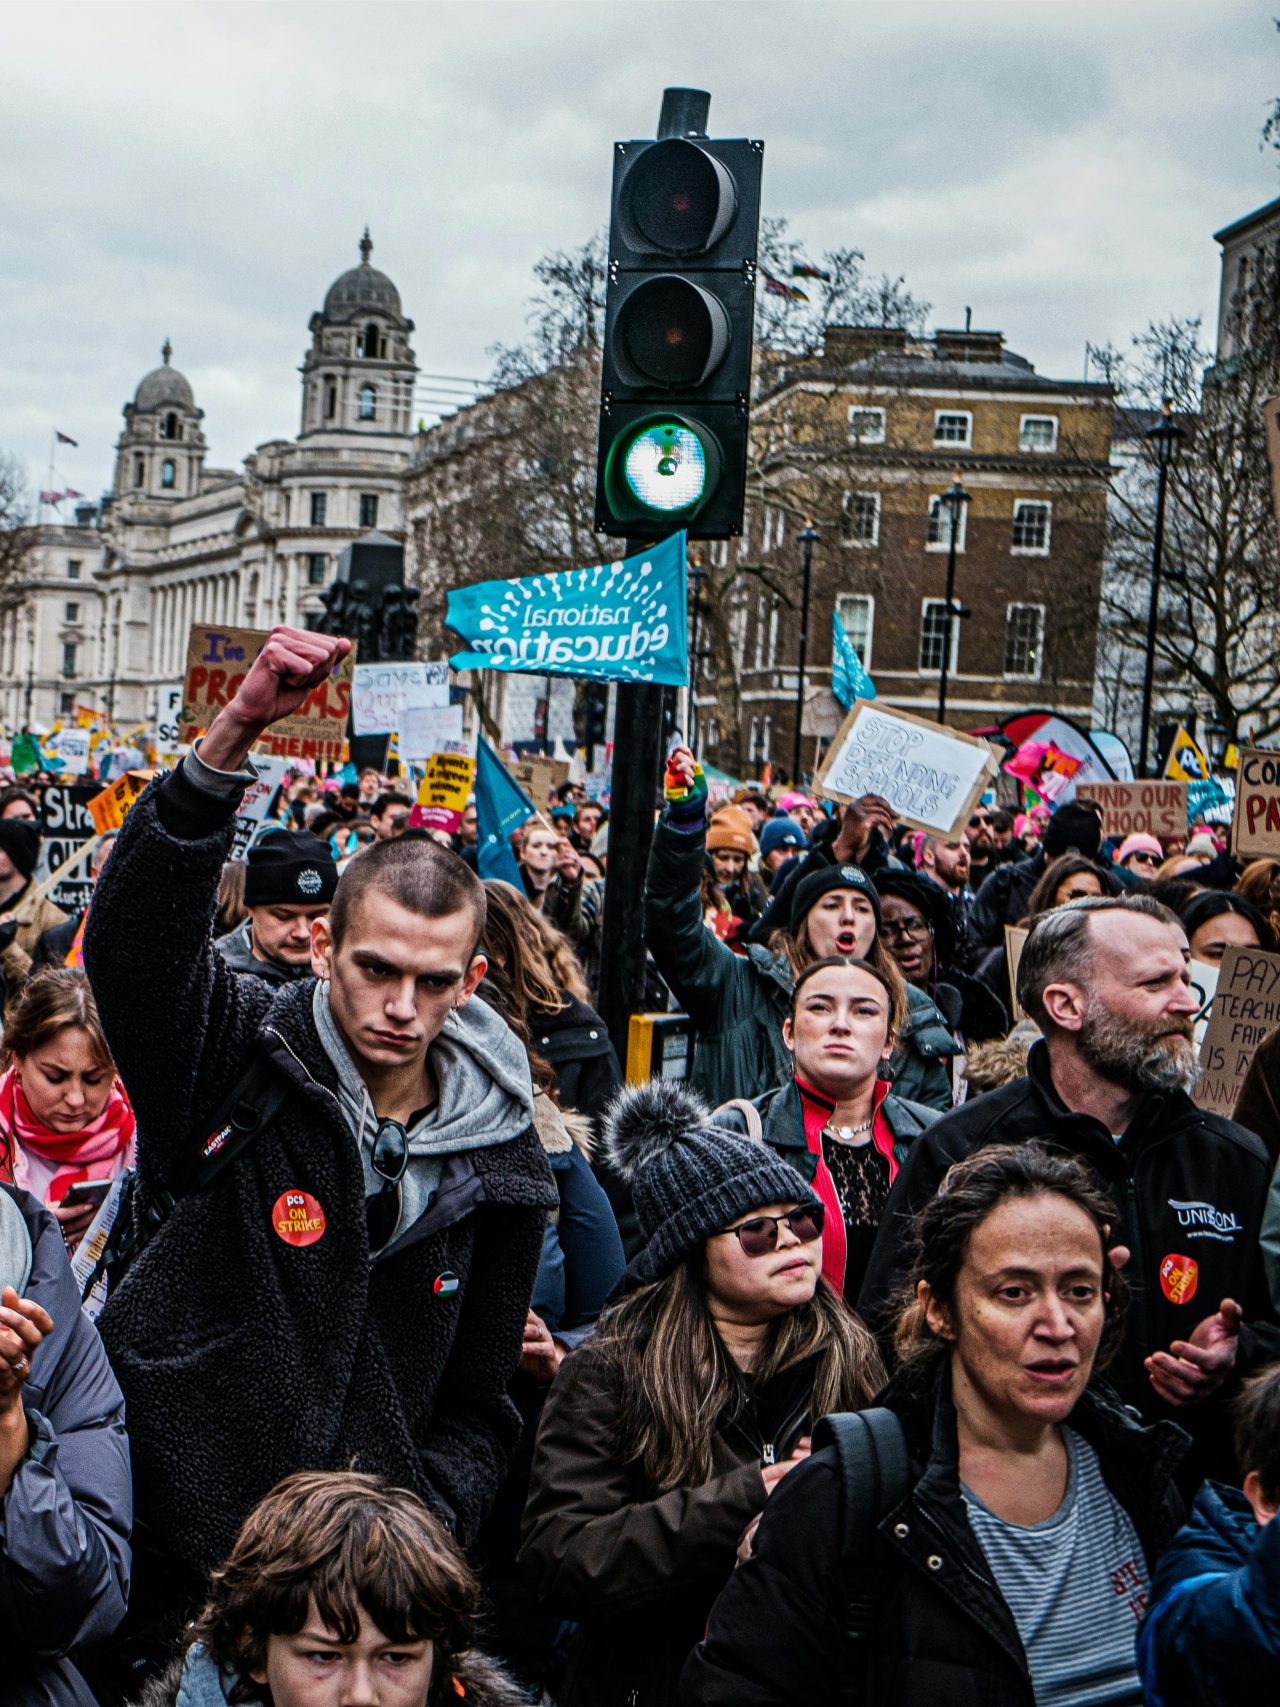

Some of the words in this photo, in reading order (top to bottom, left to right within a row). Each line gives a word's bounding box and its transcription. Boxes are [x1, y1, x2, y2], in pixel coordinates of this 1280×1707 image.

[857, 717, 925, 757] STOP
[835, 763, 940, 818] SCHOOLS
[1141, 785, 1185, 809] OUR
[1104, 809, 1176, 836] HOOLS
[1206, 1046, 1226, 1071] IS
[204, 1125, 231, 1156] EASTPAK
[278, 1218, 322, 1233] STRIKE
[289, 1208, 307, 1220] ON
[1177, 1208, 1236, 1229] UNISON
[1168, 1267, 1184, 1286] ON
